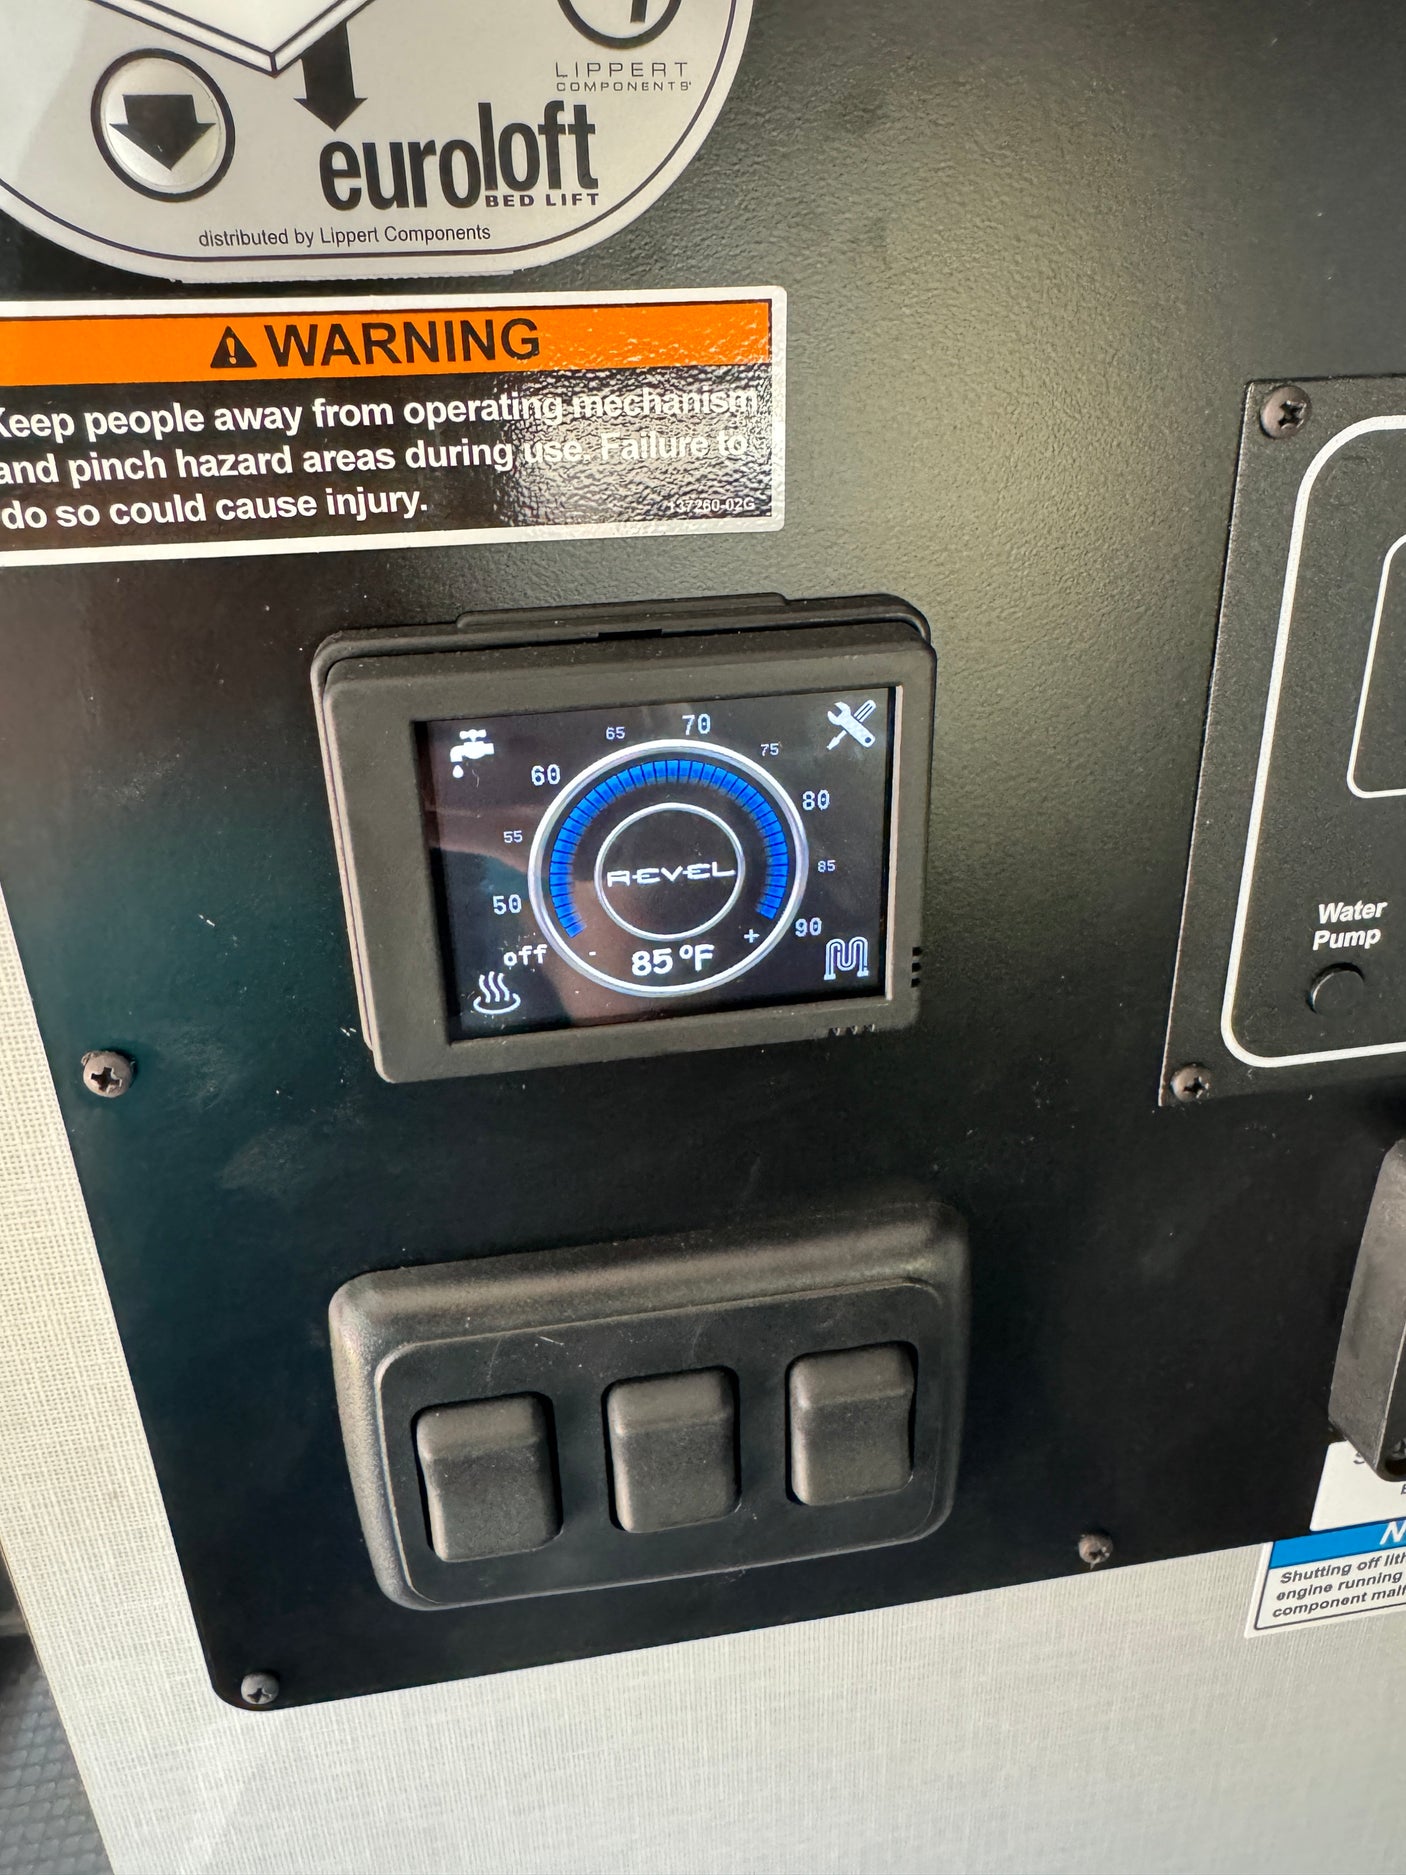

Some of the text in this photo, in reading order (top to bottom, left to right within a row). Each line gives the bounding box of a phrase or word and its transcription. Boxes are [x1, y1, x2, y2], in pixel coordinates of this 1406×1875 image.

[555, 61, 688, 78] LIPPERT
[319, 100, 599, 211] euroloft
[485, 192, 599, 208] BED LIFT
[198, 224, 491, 247] distributed by Lippert Components
[263, 317, 540, 368] WARNING
[84, 402, 205, 442] people
[214, 405, 303, 437] away
[313, 398, 394, 428] from
[403, 391, 563, 431] operating
[573, 385, 757, 419] mechanism
[0, 453, 60, 484] and
[68, 450, 168, 490] pinch
[175, 445, 293, 479] hazard
[302, 447, 396, 473] areas
[405, 438, 515, 473] during
[600, 431, 710, 461] Failure
[718, 431, 748, 456] to
[1, 486, 428, 530] do so could cause injury.
[605, 726, 626, 740] 65
[682, 713, 711, 735] 70
[760, 743, 779, 757] 75
[531, 764, 561, 786] 60
[802, 789, 830, 811] 80
[503, 830, 523, 843] 55
[606, 861, 737, 888] REVEL
[817, 859, 836, 872] 85
[493, 894, 522, 915] 50
[1318, 900, 1388, 924] Water
[794, 917, 822, 937] 90
[1312, 929, 1381, 951] Pump
[503, 944, 548, 967] off
[1280, 1564, 1352, 1584] Shutting
[1356, 1556, 1382, 1571] off
[1276, 1572, 1403, 1601] engine running
[1272, 1592, 1367, 1618] component
